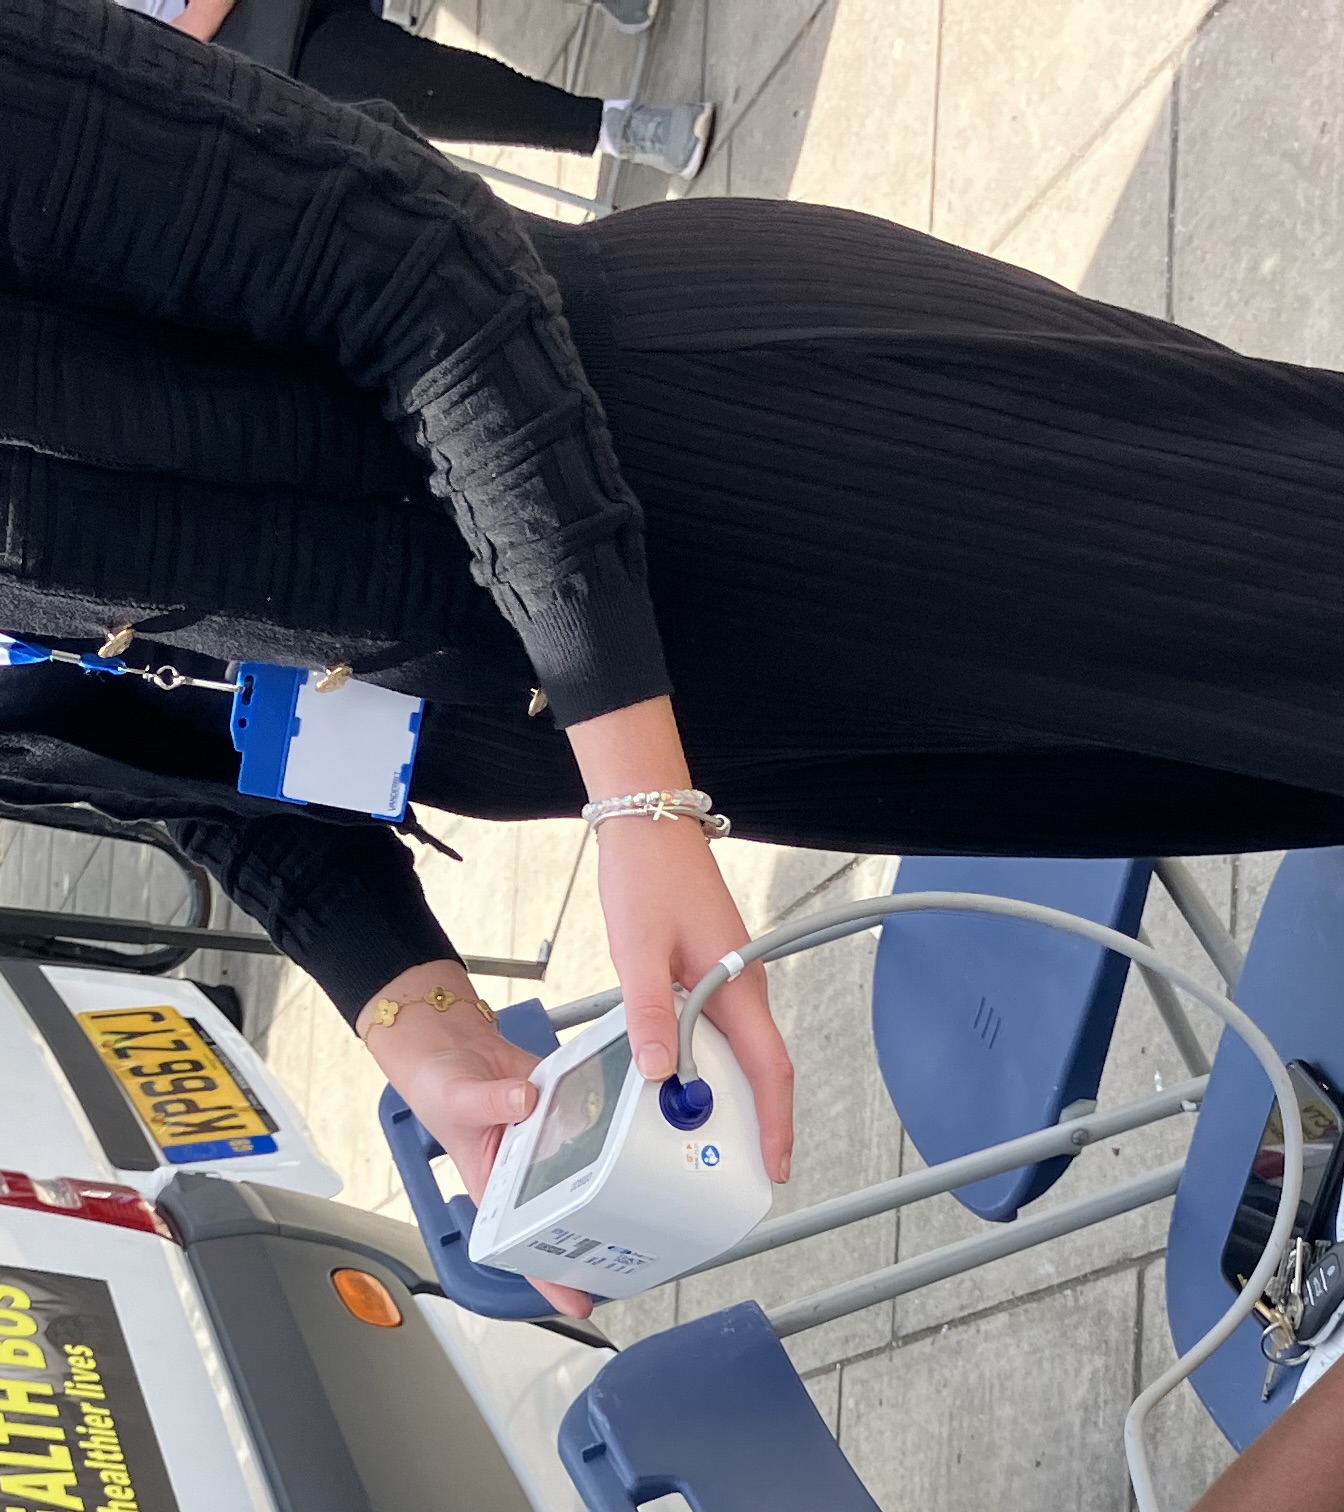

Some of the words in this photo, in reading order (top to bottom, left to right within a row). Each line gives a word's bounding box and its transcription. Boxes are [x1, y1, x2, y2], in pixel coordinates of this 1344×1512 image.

[90, 1011, 192, 1059] ZYJ
[129, 1059, 247, 1138] KP66
[61, 1343, 108, 1399] lives
